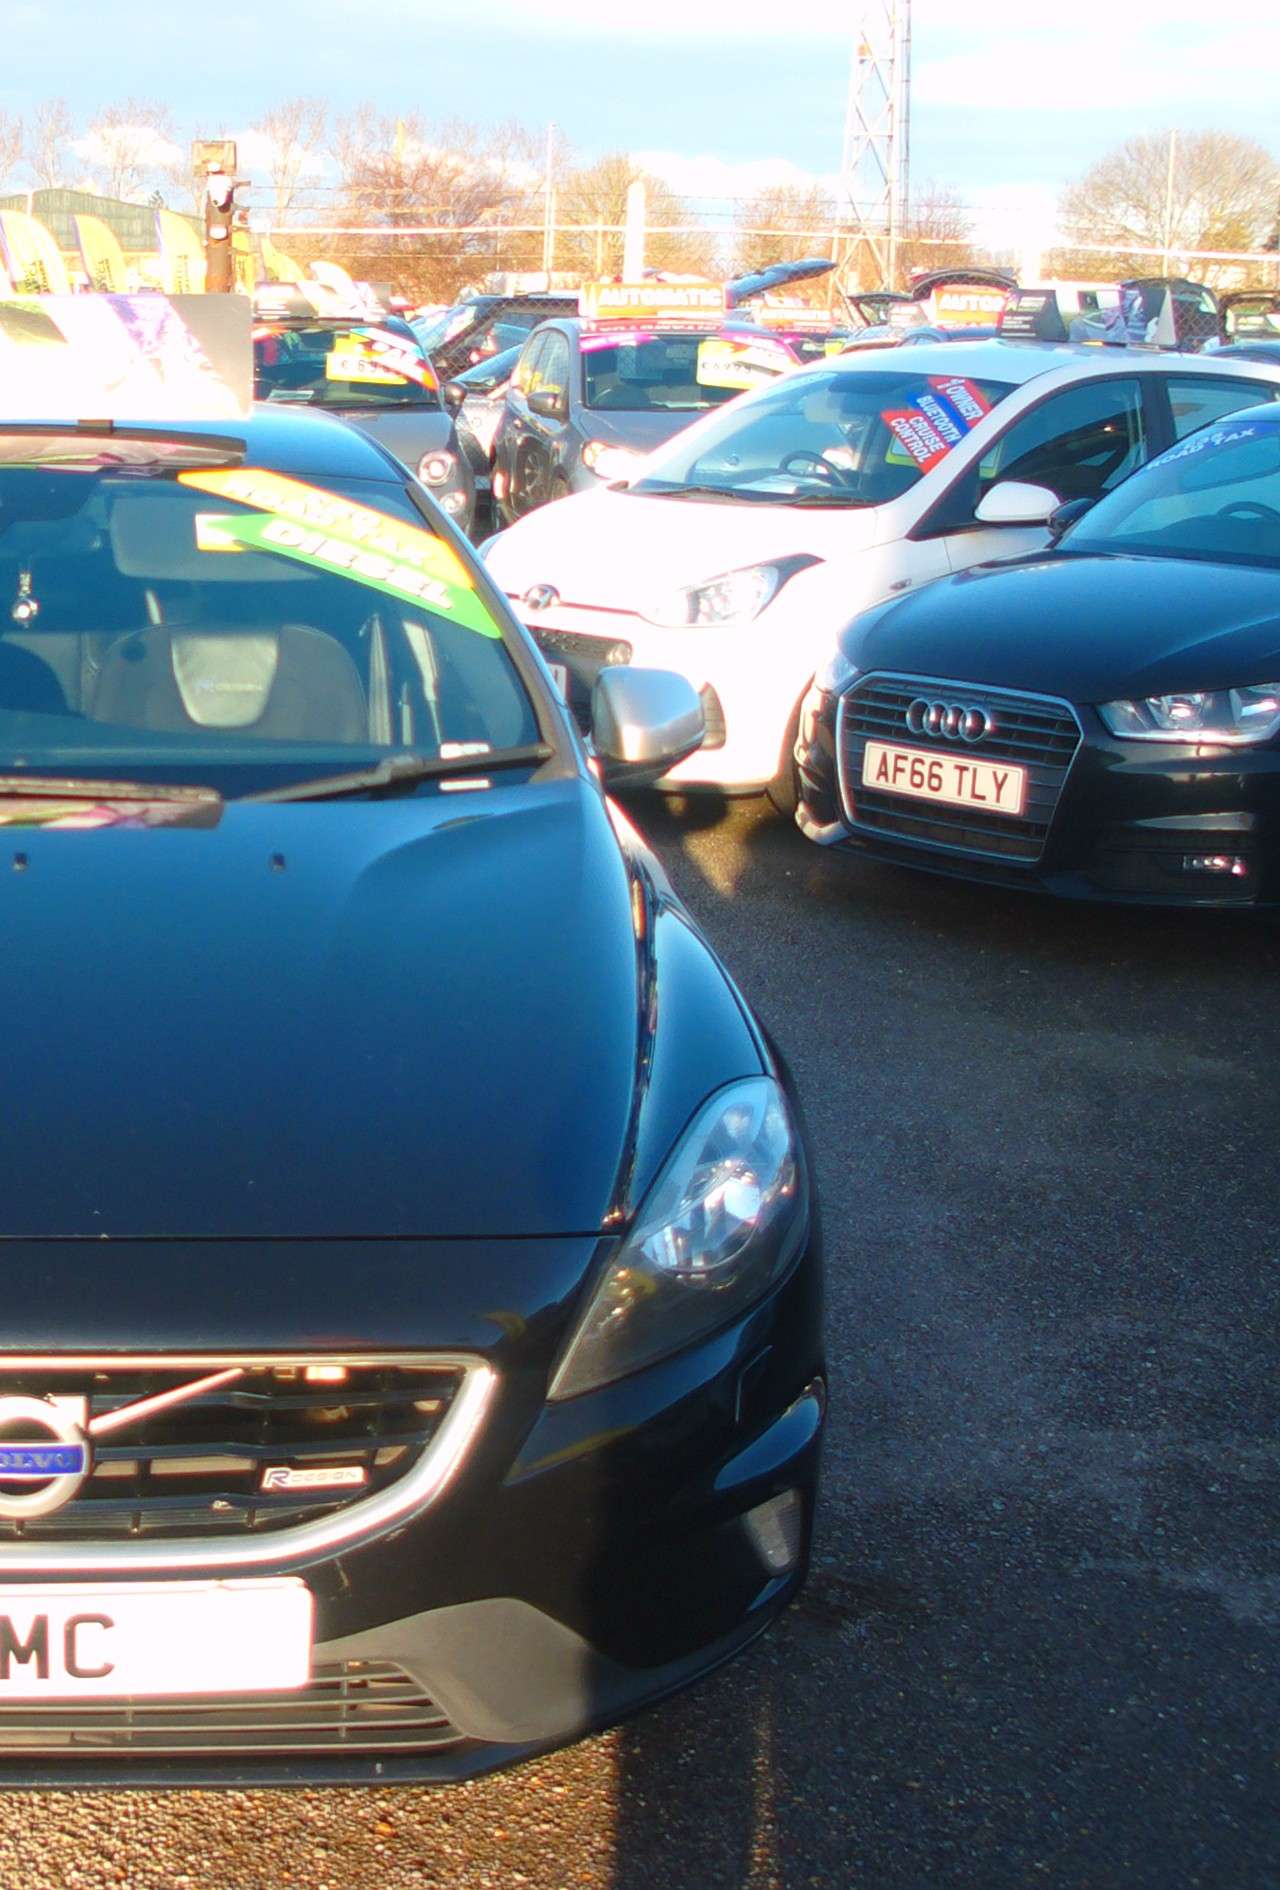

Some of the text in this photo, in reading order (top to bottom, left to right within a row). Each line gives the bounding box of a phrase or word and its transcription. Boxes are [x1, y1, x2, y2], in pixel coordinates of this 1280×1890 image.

[916, 395, 962, 443] BLUETOOTH
[945, 385, 984, 421] OWNER
[890, 417, 931, 463] CONTROL
[909, 416, 946, 453] CRUISE
[261, 519, 454, 609] DIESEL
[876, 751, 1009, 804] AF66 TLY
